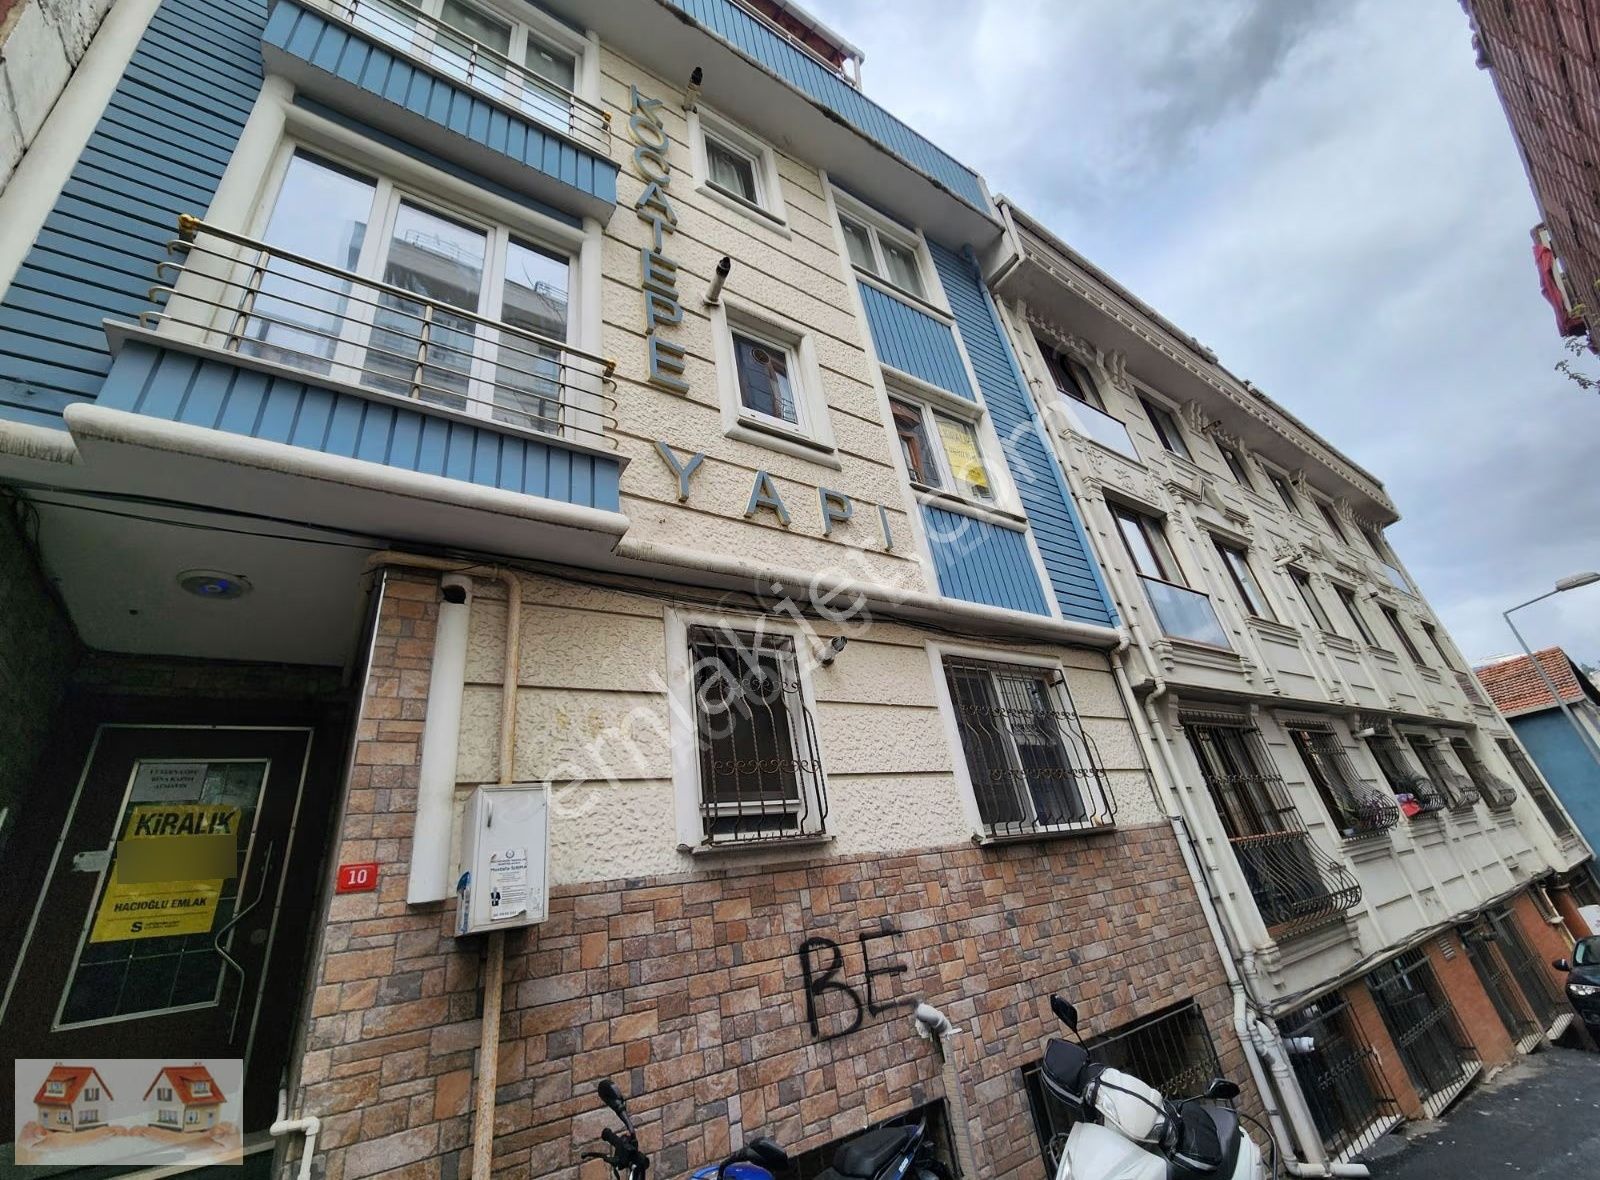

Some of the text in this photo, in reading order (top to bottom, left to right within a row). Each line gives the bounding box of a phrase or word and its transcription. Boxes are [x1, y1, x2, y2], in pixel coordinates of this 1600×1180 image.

[627, 81, 690, 394] KOCATEPE
[654, 441, 894, 552] YAPI
[171, 897, 207, 908] EMLAK
[348, 869, 367, 885] 10
